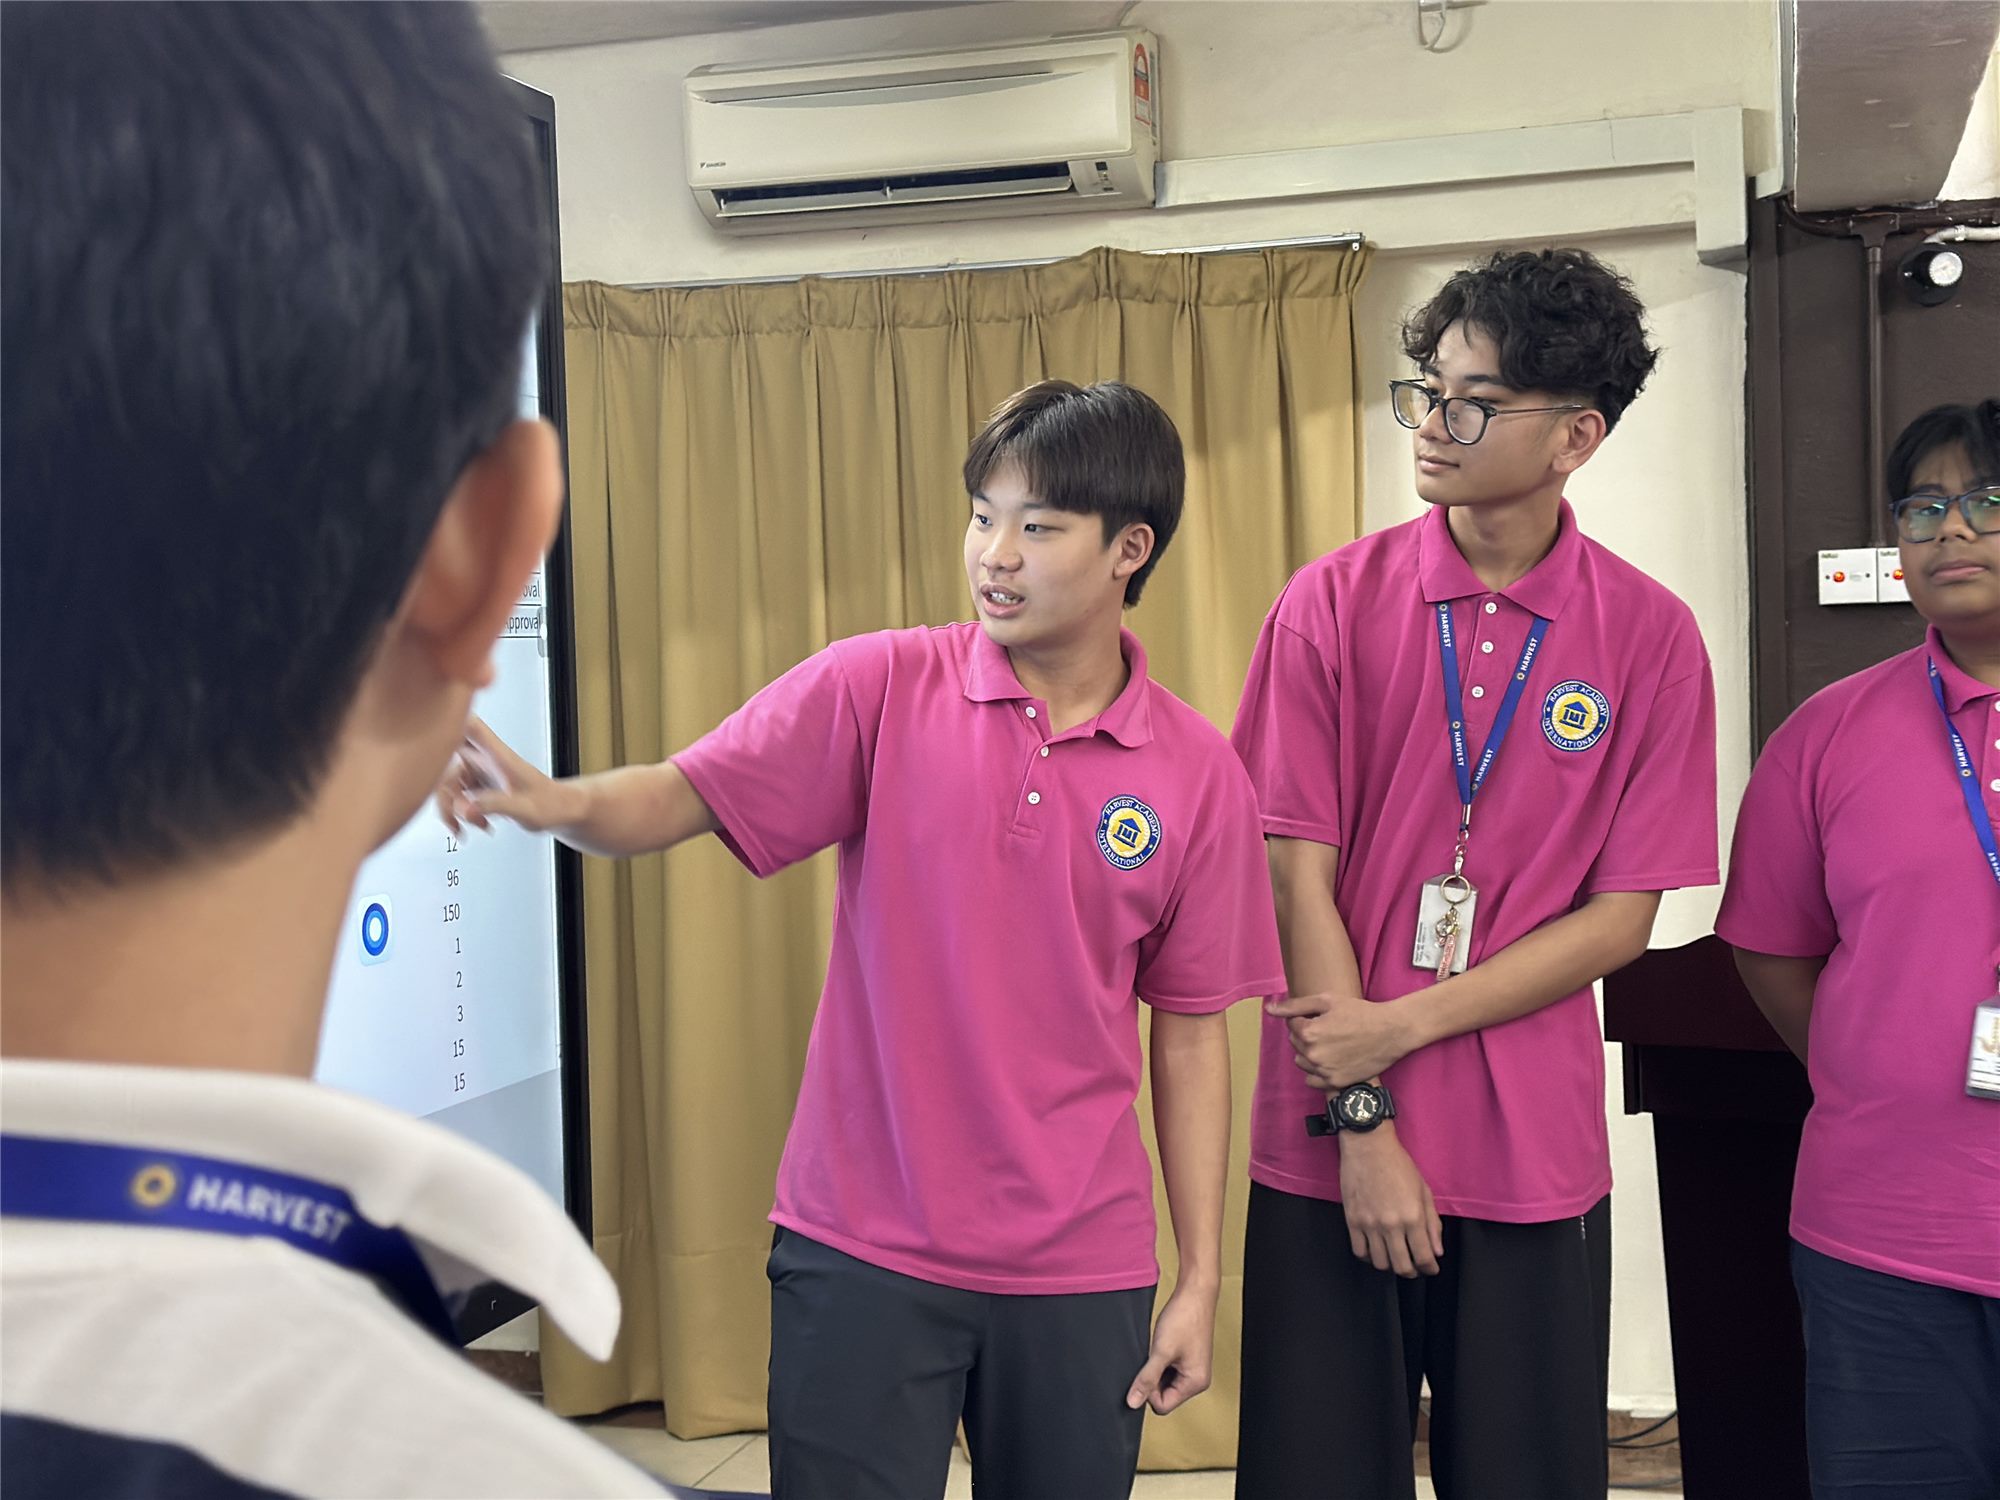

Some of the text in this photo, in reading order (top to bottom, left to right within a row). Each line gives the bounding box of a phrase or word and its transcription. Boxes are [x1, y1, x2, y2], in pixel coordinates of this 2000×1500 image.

[1441, 613, 1452, 648] HARVEST
[1520, 637, 1538, 671] HARVEST
[1549, 684, 1607, 717] HARVEST ACADEMY
[1544, 718, 1596, 748] INTERNATIONAL
[1454, 731, 1465, 767] HARVEST
[1475, 749, 1494, 782] HARVEST
[1105, 800, 1158, 838] HARVEST ACADEMY
[1099, 829, 1146, 866] INTERNATIONAL
[447, 869, 459, 887] 96
[443, 903, 460, 922] 150
[456, 937, 461, 954] 1
[456, 971, 462, 988] 2
[457, 1005, 464, 1022] 3
[453, 1039, 465, 1057] 15
[454, 1073, 466, 1092] 15
[187, 1174, 351, 1243] HARVEST
